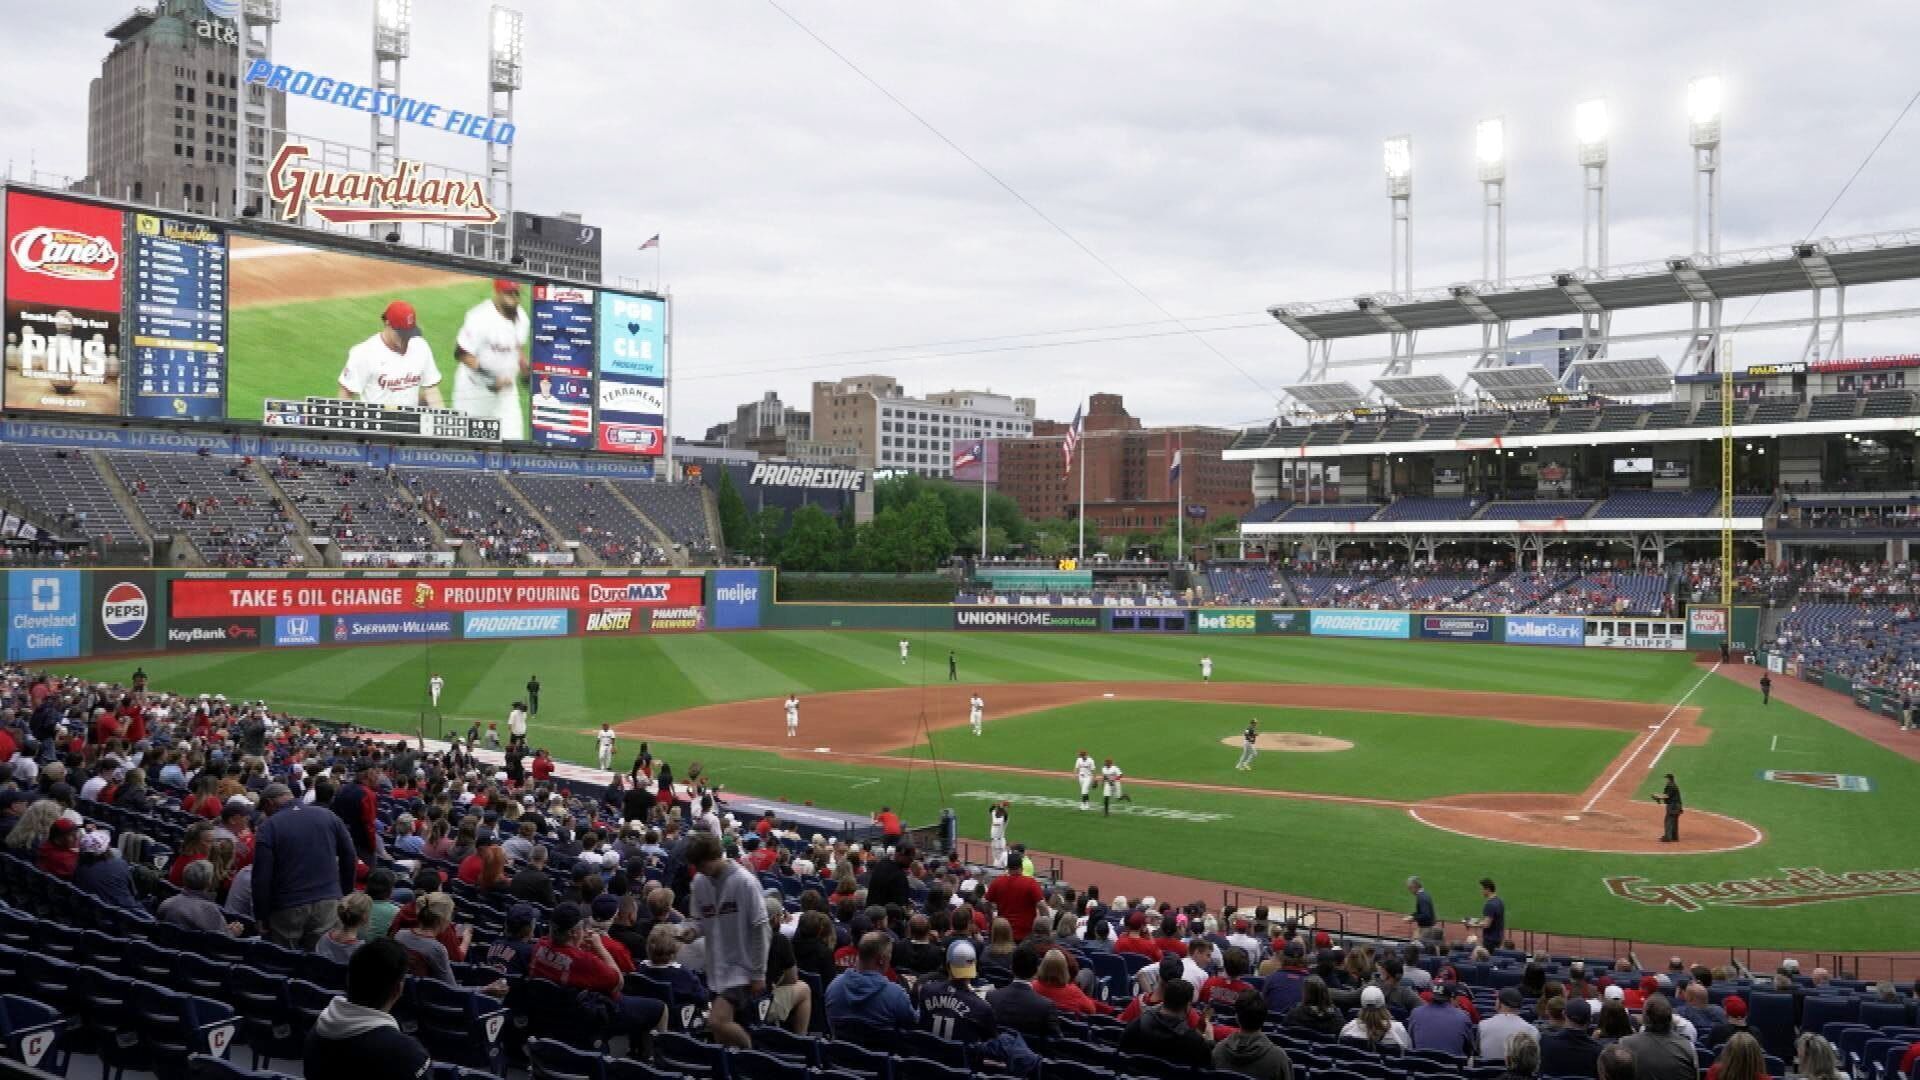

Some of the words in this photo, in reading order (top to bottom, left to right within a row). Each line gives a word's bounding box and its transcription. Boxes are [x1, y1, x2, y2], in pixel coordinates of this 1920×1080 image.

[196, 19, 239, 45] at&
[244, 58, 441, 127] PROGRESSIVE
[443, 109, 517, 145] FIELD
[267, 142, 500, 224] Guardians
[18, 227, 115, 271] Cane's
[30, 426, 121, 443] HONDA
[150, 431, 230, 449] HONDA
[290, 444, 361, 457] HONDA
[415, 451, 478, 464] HONDA
[524, 458, 580, 471] HONDA
[597, 463, 648, 474] HONDA
[750, 463, 864, 490] PROGRESSIVE
[230, 589, 277, 607] TAKE
[283, 589, 293, 607] 5
[298, 588, 326, 607] OIL
[331, 587, 402, 605] CHANGE
[444, 586, 512, 604] PROUDLY
[517, 585, 580, 602] POURING
[716, 583, 758, 605] meijer
[105, 605, 145, 618] PEPSI
[653, 608, 698, 619] PHANTOM
[1692, 610, 1720, 625] drug
[14, 613, 77, 629] Cleveland
[466, 614, 561, 633] PROGRESSIVE
[586, 613, 631, 631] BLASTER
[1198, 614, 1256, 629] bet365
[1313, 614, 1403, 632] PROGRESSIVE
[26, 633, 64, 649] Clinic
[168, 627, 226, 642] KeyBank
[1623, 636, 1673, 649] CLIFFS
[932, 1014, 956, 1040] 11
